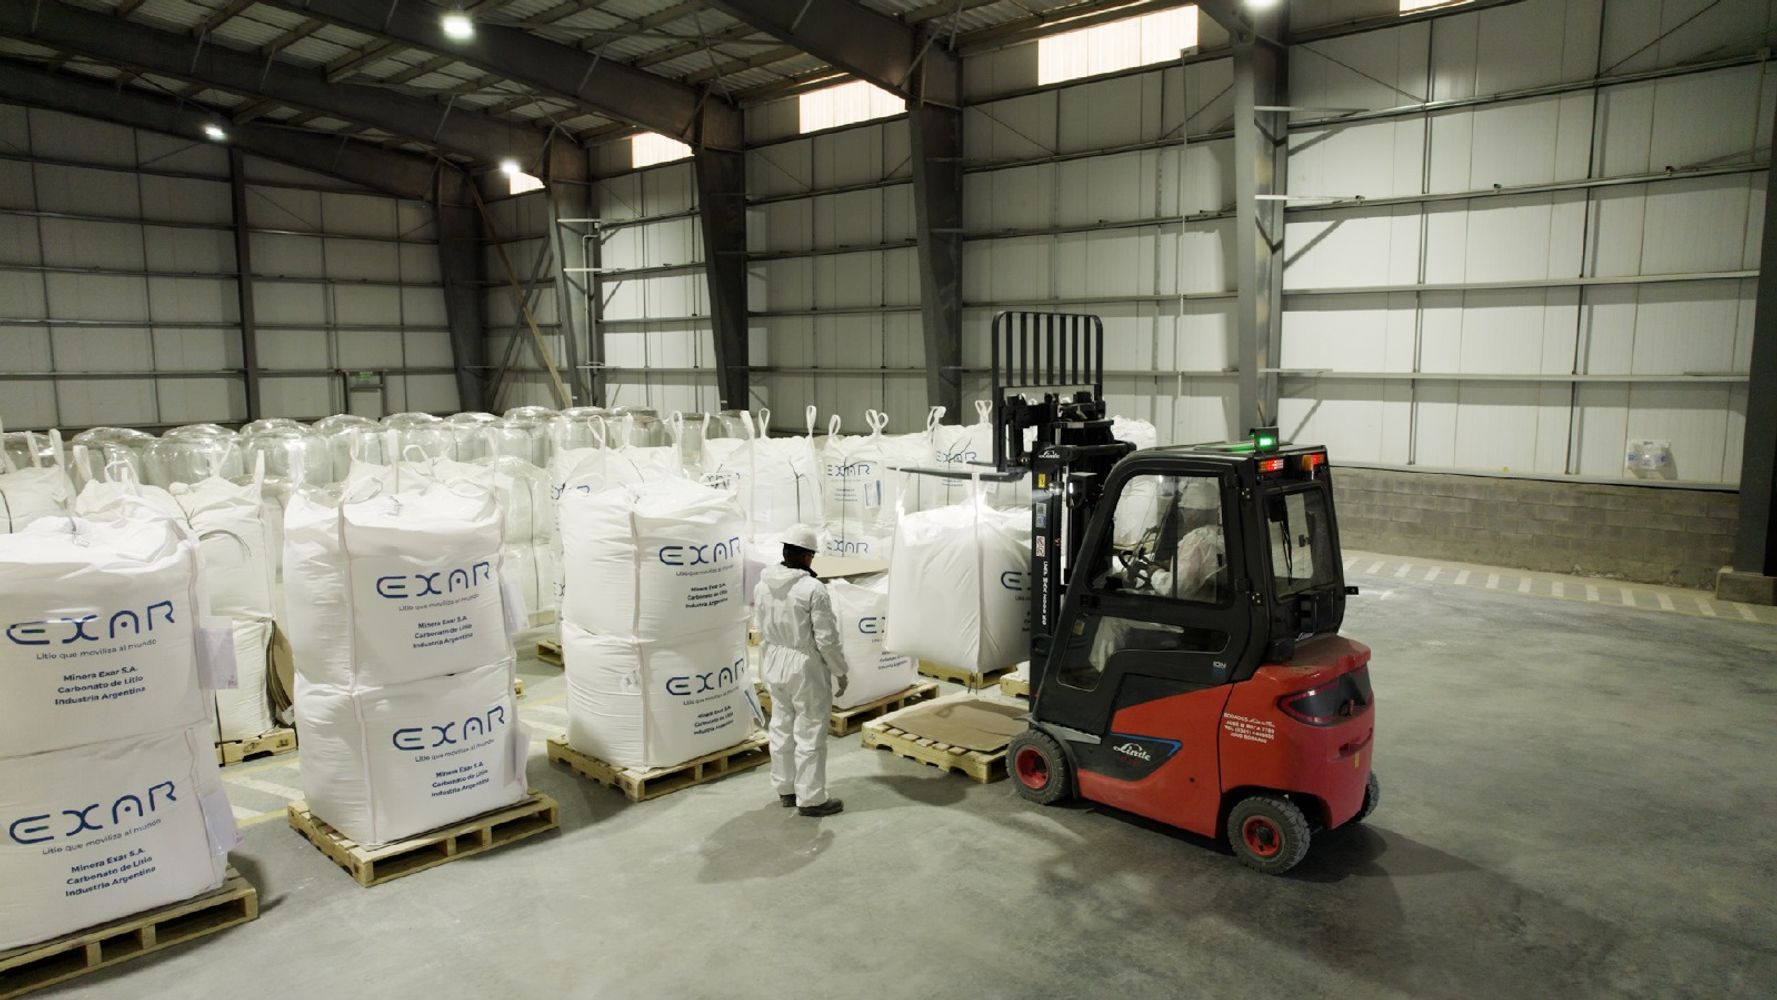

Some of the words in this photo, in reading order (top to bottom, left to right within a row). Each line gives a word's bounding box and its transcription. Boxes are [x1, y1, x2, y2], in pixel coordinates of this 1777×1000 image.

[659, 537, 741, 565] EXAR
[376, 562, 489, 599] EXAR
[6, 600, 175, 645] EXAR
[36, 651, 57, 660] Litio
[59, 651, 77, 660] que
[80, 646, 117, 657] moviliza
[119, 644, 127, 652] al
[128, 639, 157, 650] mundo
[58, 681, 109, 694] Carbonato
[110, 679, 122, 687] de
[124, 675, 143, 685] Litio
[63, 672, 97, 682] Minera
[99, 669, 120, 678] Exar
[55, 693, 99, 706] Industria
[101, 686, 146, 700] Argentina
[393, 705, 504, 751] EXAR
[1113, 743, 1151, 761] Linde
[9, 781, 177, 845] EXAR
[42, 846, 63, 855] Litio
[65, 843, 83, 853] que
[86, 832, 122, 847] moviliza
[124, 829, 132, 837] al
[134, 818, 161, 834] mundo
[67, 869, 118, 885] Carbonato
[120, 863, 132, 872] de
[133, 855, 152, 868] Litio
[71, 860, 105, 873] Minera
[106, 854, 127, 865] Exar
[65, 882, 110, 897] Industria
[112, 866, 156, 885] Argentina
